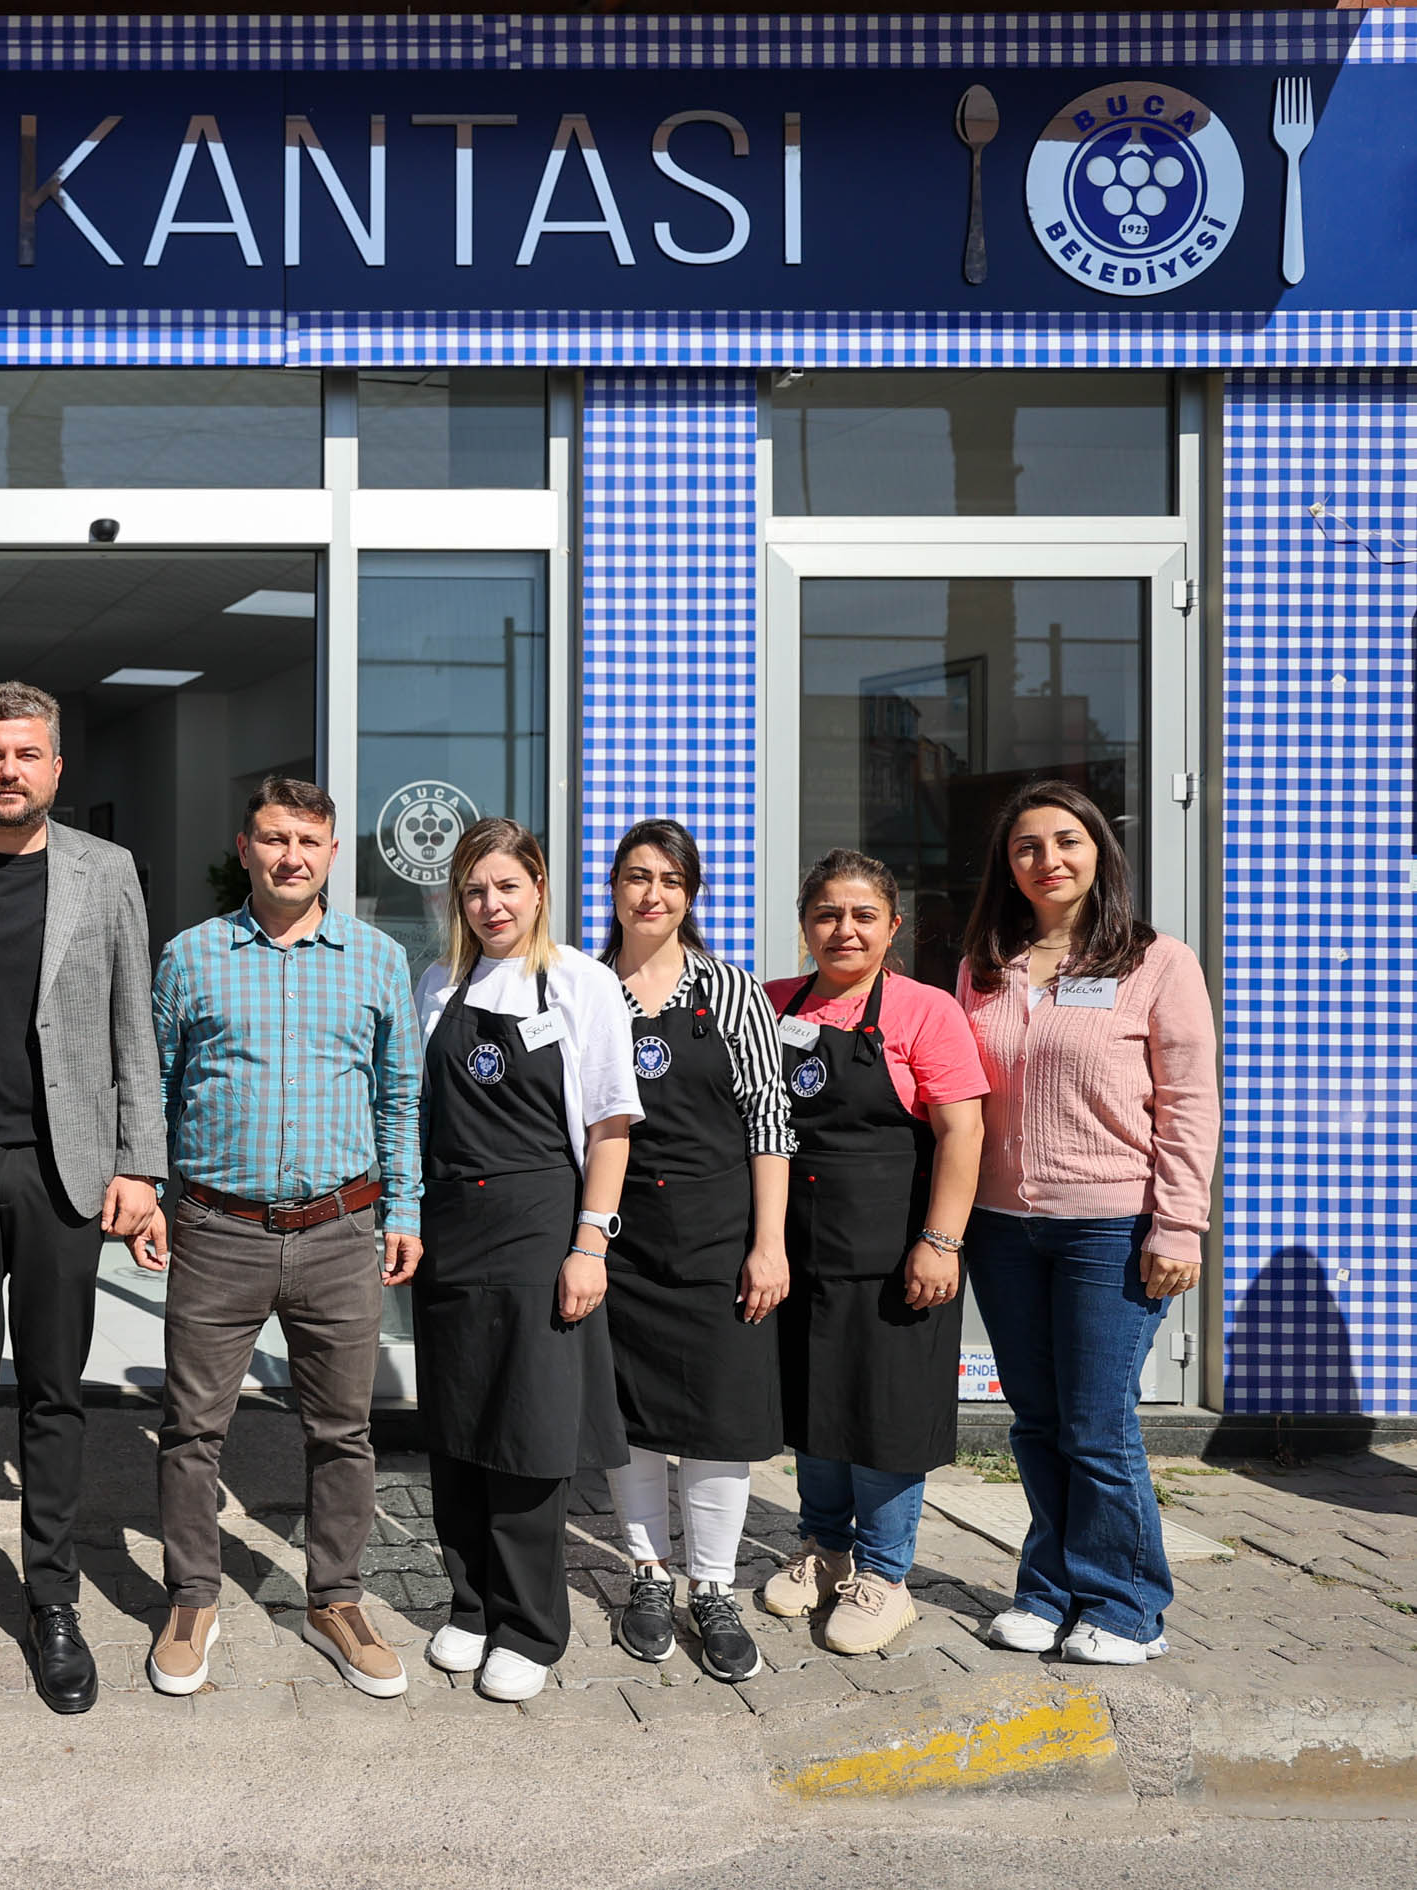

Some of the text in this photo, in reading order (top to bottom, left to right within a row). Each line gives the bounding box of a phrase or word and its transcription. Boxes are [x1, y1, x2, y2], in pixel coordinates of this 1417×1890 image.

[1072, 95, 1196, 132] BUCA
[1120, 223, 1148, 235] 1923
[1045, 215, 1227, 286] BELEDİYESİ
[400, 787, 459, 808] BUCA
[385, 847, 449, 881] BELEDİY
